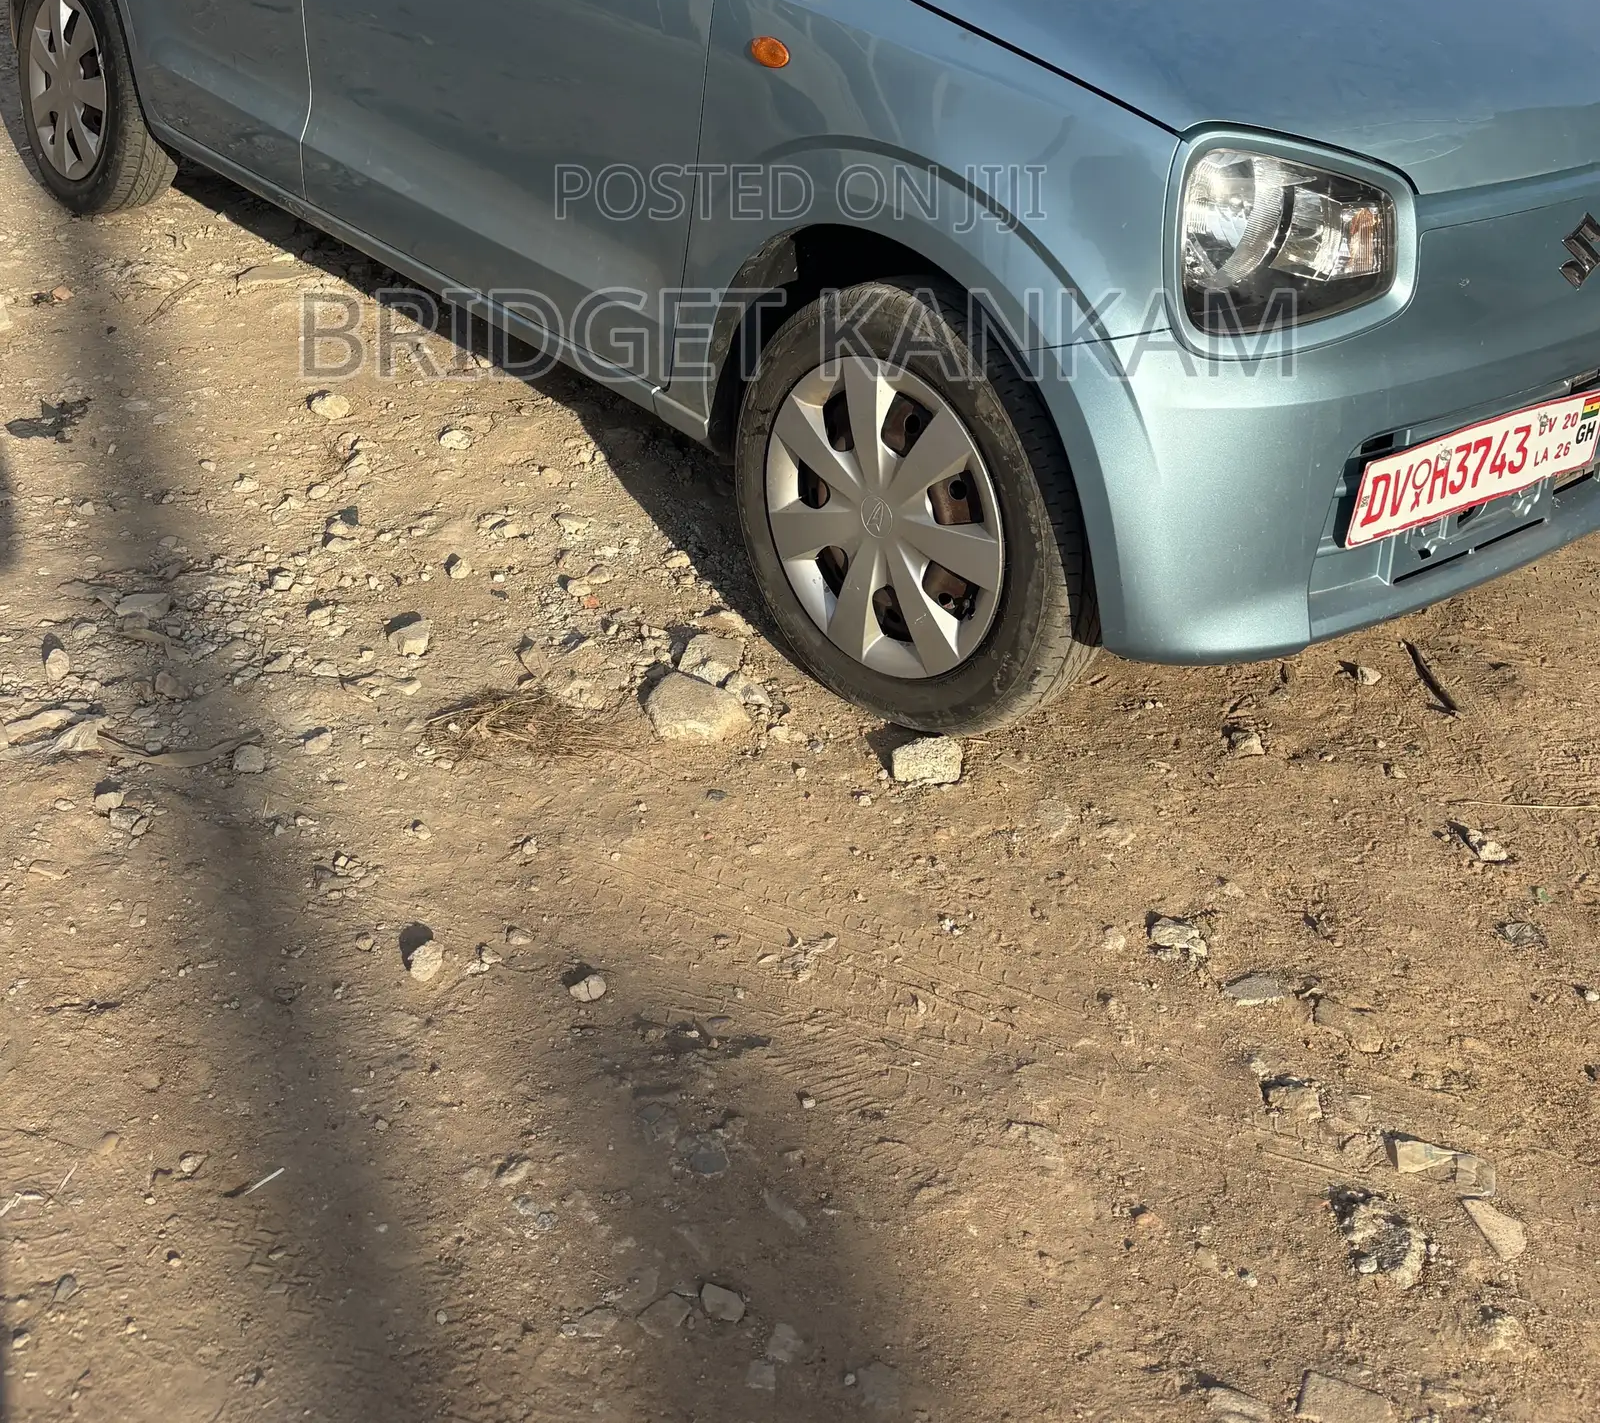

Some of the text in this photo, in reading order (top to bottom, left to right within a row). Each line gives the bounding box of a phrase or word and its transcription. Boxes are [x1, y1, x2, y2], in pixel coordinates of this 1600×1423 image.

[1562, 411, 1579, 429] 20
[1576, 421, 1597, 444] GH
[1534, 441, 1571, 467] LA 26
